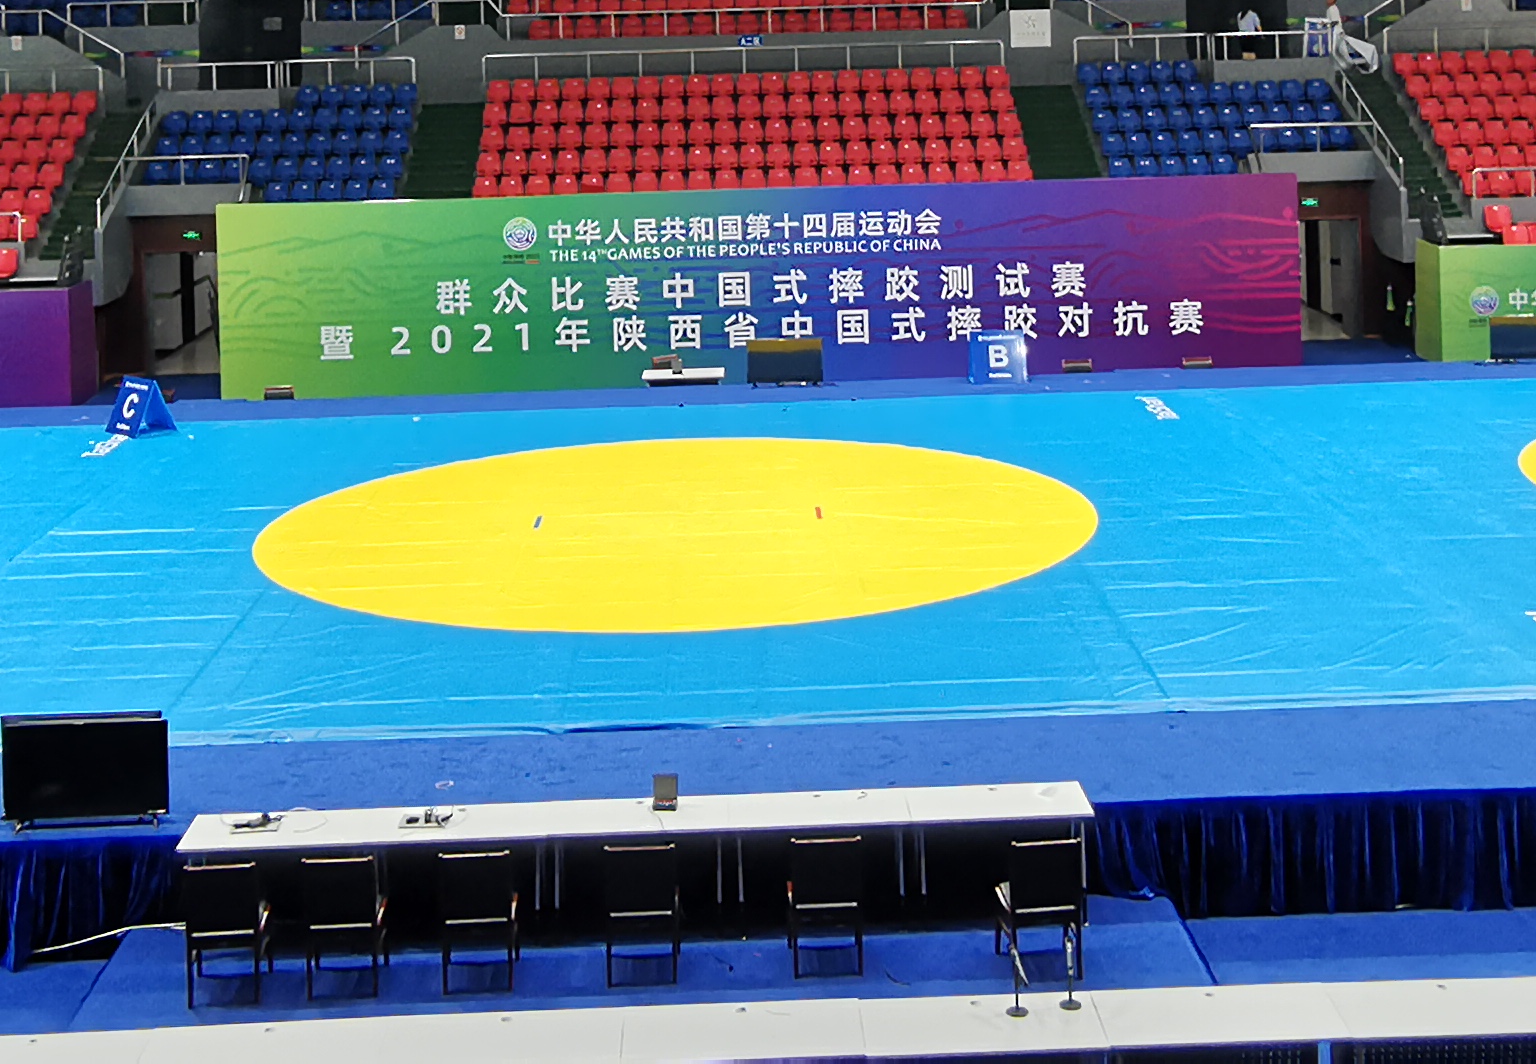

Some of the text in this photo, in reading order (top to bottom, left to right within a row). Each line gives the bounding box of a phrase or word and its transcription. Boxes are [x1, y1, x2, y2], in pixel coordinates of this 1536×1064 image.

[548, 208, 942, 247] 中华人民共和国第十四届运动会
[550, 249, 579, 262] THE
[607, 247, 661, 261] GAMES
[664, 246, 684, 259] OF
[687, 245, 716, 258] THE
[719, 242, 791, 257] PEOPLE'S
[794, 240, 868, 254] REPUBLIC
[870, 239, 890, 253] OF
[893, 238, 942, 252] CHINA
[436, 262, 1086, 316] 群众比赛中国式摔跤测试赛
[988, 344, 1010, 368] B
[122, 393, 139, 419] C
